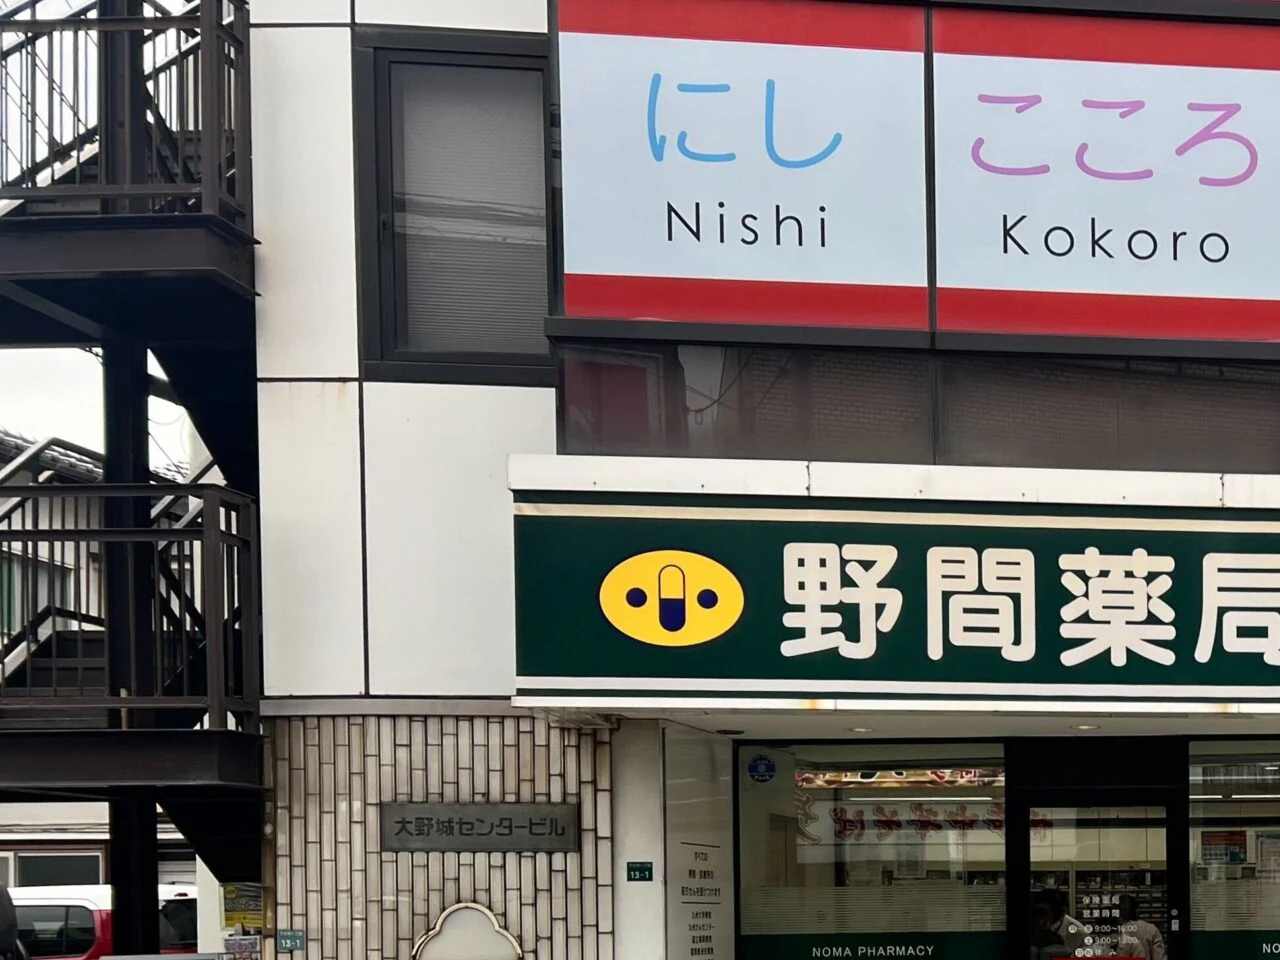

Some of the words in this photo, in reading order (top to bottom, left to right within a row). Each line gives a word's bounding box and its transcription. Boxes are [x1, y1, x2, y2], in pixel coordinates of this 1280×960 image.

[647, 73, 842, 168] にし
[971, 94, 1258, 187] こころ
[667, 201, 827, 247] Nishi
[1002, 214, 1229, 263] Kokoro
[394, 817, 566, 837] 大野城センタービル
[631, 871, 649, 879] 13-1
[281, 939, 300, 948] 13-1
[812, 946, 852, 957] NOMA
[857, 945, 934, 957] PHARMACY
